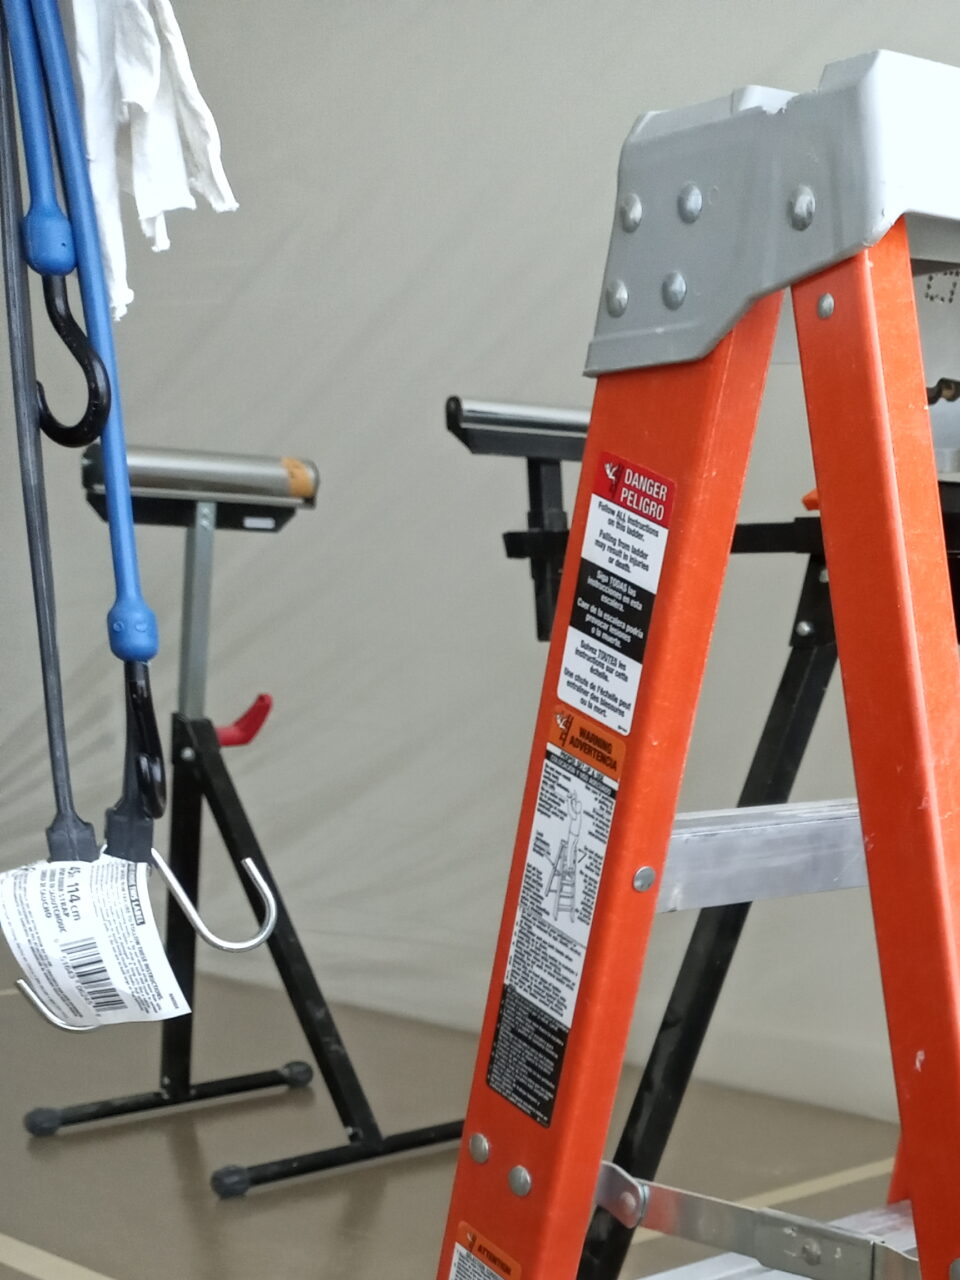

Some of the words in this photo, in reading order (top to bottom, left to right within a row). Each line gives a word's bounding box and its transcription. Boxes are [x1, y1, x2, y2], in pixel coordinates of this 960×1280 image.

[623, 468, 667, 502] DANGER
[598, 501, 615, 515] Follow
[616, 510, 626, 521] ALL
[620, 488, 664, 520] PELIGRO
[598, 529, 616, 545] Falling
[617, 539, 630, 550] from
[631, 546, 648, 560] ladder
[616, 522, 625, 531] this
[626, 527, 645, 541] ladder.
[594, 540, 605, 550] may
[607, 545, 622, 557] result
[629, 556, 649, 571] injuries
[615, 560, 631, 573] death.
[596, 570, 608, 583] Siga
[609, 577, 627, 592] TODAS
[627, 587, 636, 597] las
[577, 597, 589, 610] Caer
[590, 605, 596, 614] de
[597, 609, 603, 617] la
[603, 612, 625, 629] escalera
[622, 595, 629, 603] en
[630, 599, 642, 611] esta
[585, 614, 608, 632] provocar
[608, 625, 631, 642] lesiones
[596, 628, 601, 637] la
[575, 647, 604, 668] instructions
[615, 669, 628, 682] cette
[597, 650, 617, 667] TOUTES
[618, 661, 626, 670] les
[574, 674, 588, 686] chute
[589, 682, 595, 690] de
[619, 699, 631, 711] peut
[590, 693, 598, 702] des
[600, 698, 625, 717] blessures
[569, 735, 617, 770] ADVERTENCIA
[578, 727, 612, 754] WARNING
[67, 882, 82, 904] 114
[71, 905, 82, 921] cm
[144, 961, 164, 1000] INSTRUCTIONS
